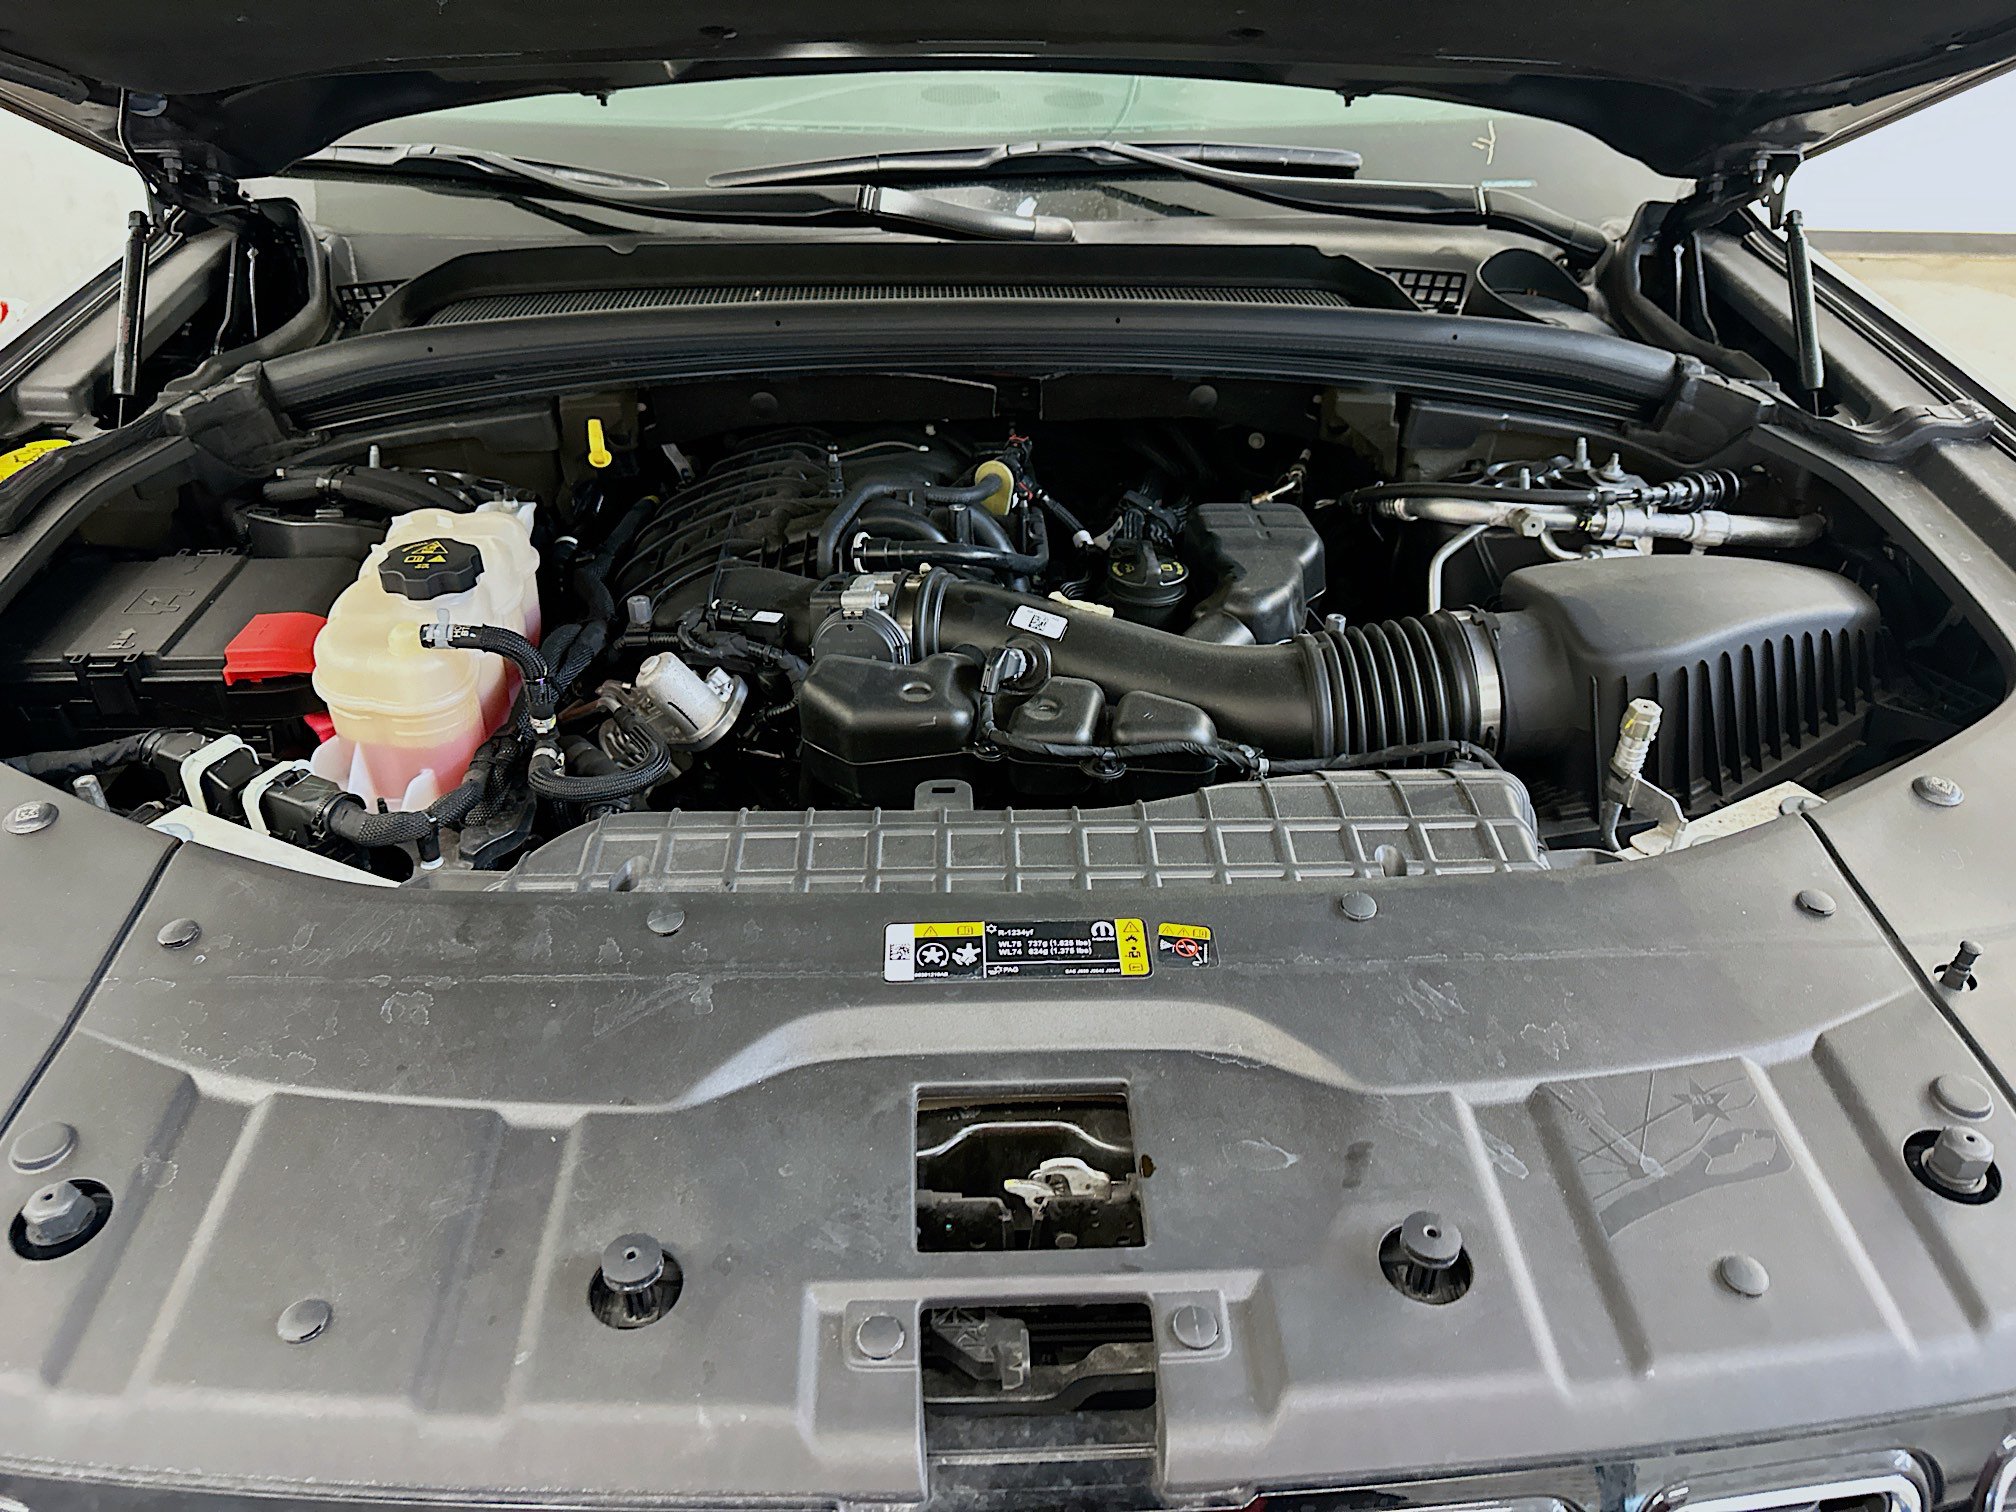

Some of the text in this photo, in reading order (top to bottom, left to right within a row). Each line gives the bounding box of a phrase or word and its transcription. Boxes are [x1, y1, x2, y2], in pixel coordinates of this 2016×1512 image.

[997, 928, 1035, 937] R-1234yf
[998, 940, 1022, 948] WL75
[1027, 940, 1048, 948] 737g
